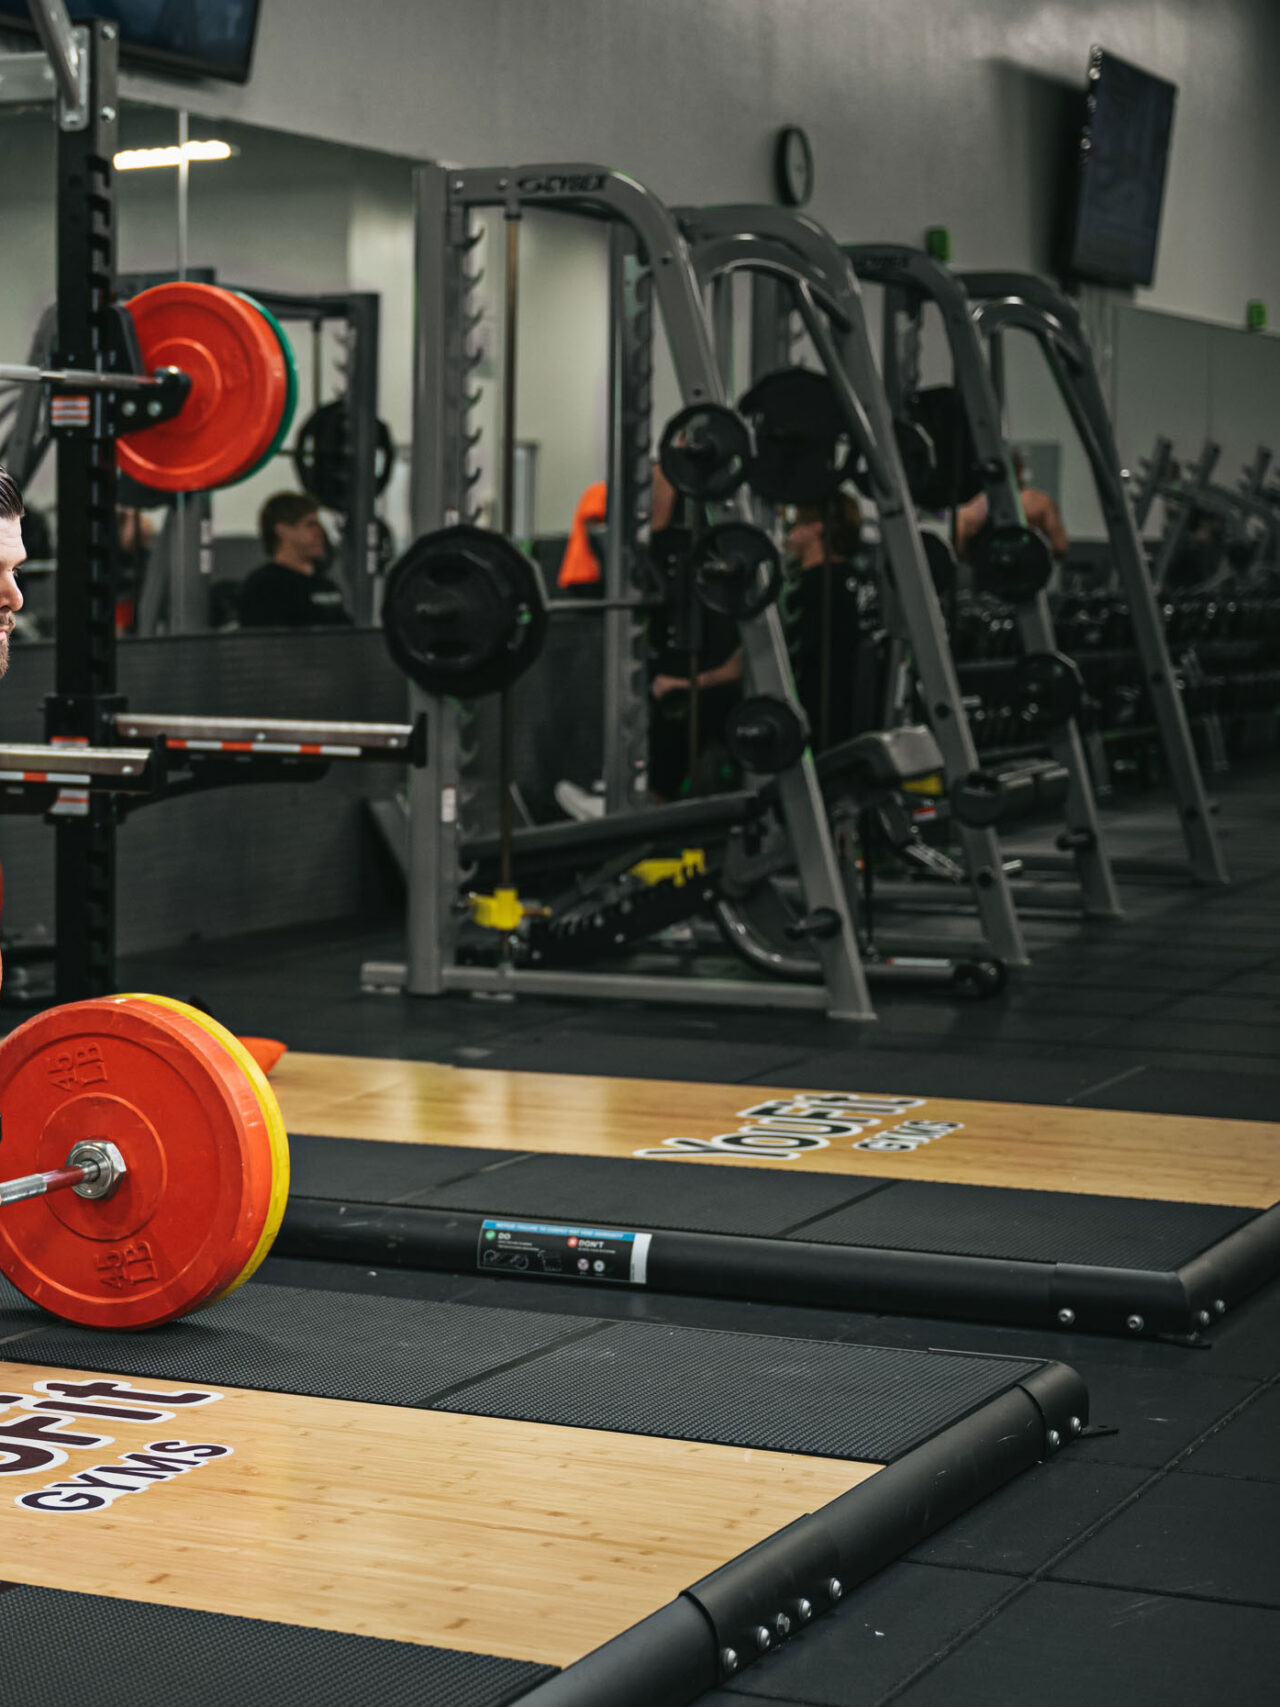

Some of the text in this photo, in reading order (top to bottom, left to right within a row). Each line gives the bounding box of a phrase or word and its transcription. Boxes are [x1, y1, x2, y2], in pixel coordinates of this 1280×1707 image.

[47, 1051, 77, 1093] 45
[75, 1041, 108, 1089] LB
[497, 1232, 511, 1240] DO
[578, 1239, 605, 1248] DON'T
[17, 1440, 231, 1511] GYMS
